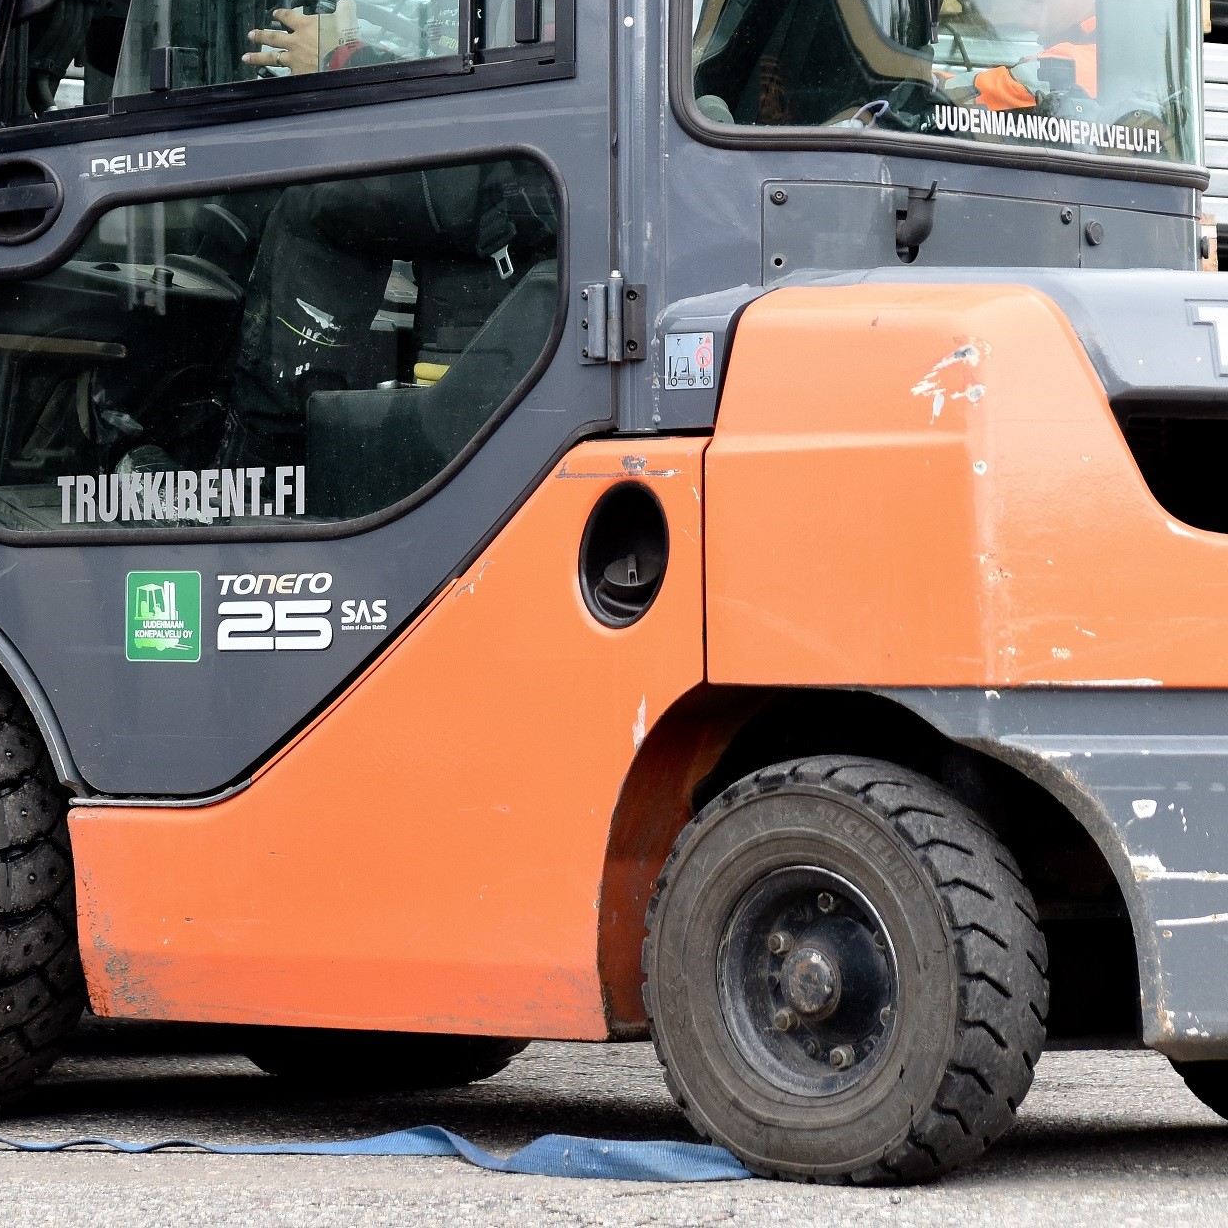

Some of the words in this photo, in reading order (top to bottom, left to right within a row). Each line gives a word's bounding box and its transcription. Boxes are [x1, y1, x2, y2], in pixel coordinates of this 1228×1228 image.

[934, 104, 1161, 154] UUDENMAANKONEPALVELU.FI
[90, 147, 187, 178] DELUXE
[57, 465, 306, 524] TRUKKIRENT.FI
[142, 620, 185, 629] UUDENMAAN
[217, 599, 334, 652] 25
[341, 599, 388, 624] SAS
[134, 629, 182, 639] KONEPALVELU
[182, 629, 194, 639] OY
